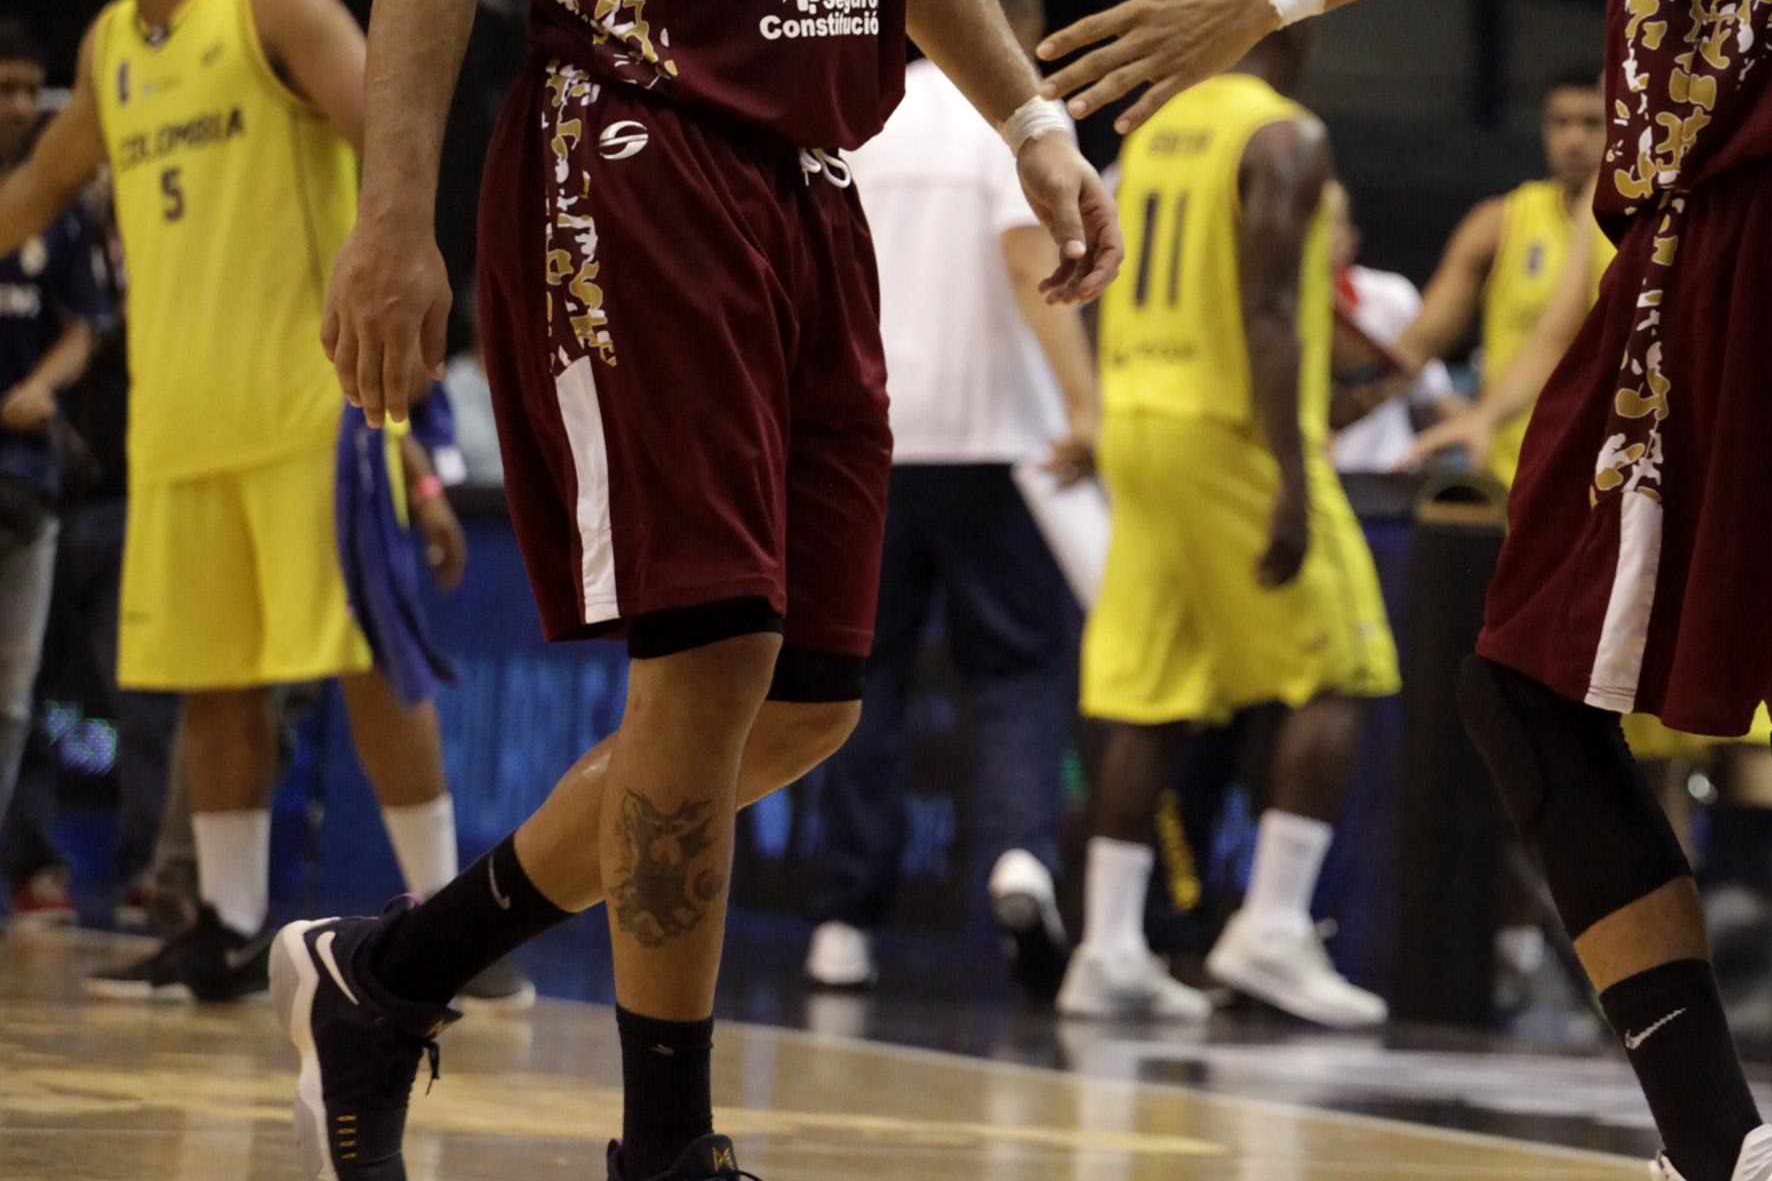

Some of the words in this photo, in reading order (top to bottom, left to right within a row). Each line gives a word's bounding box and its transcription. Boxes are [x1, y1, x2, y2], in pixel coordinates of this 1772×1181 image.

[759, 11, 880, 40] Constitució
[119, 105, 245, 170] COLOMBIA
[161, 166, 185, 222] 5
[1134, 189, 1191, 308] 11
